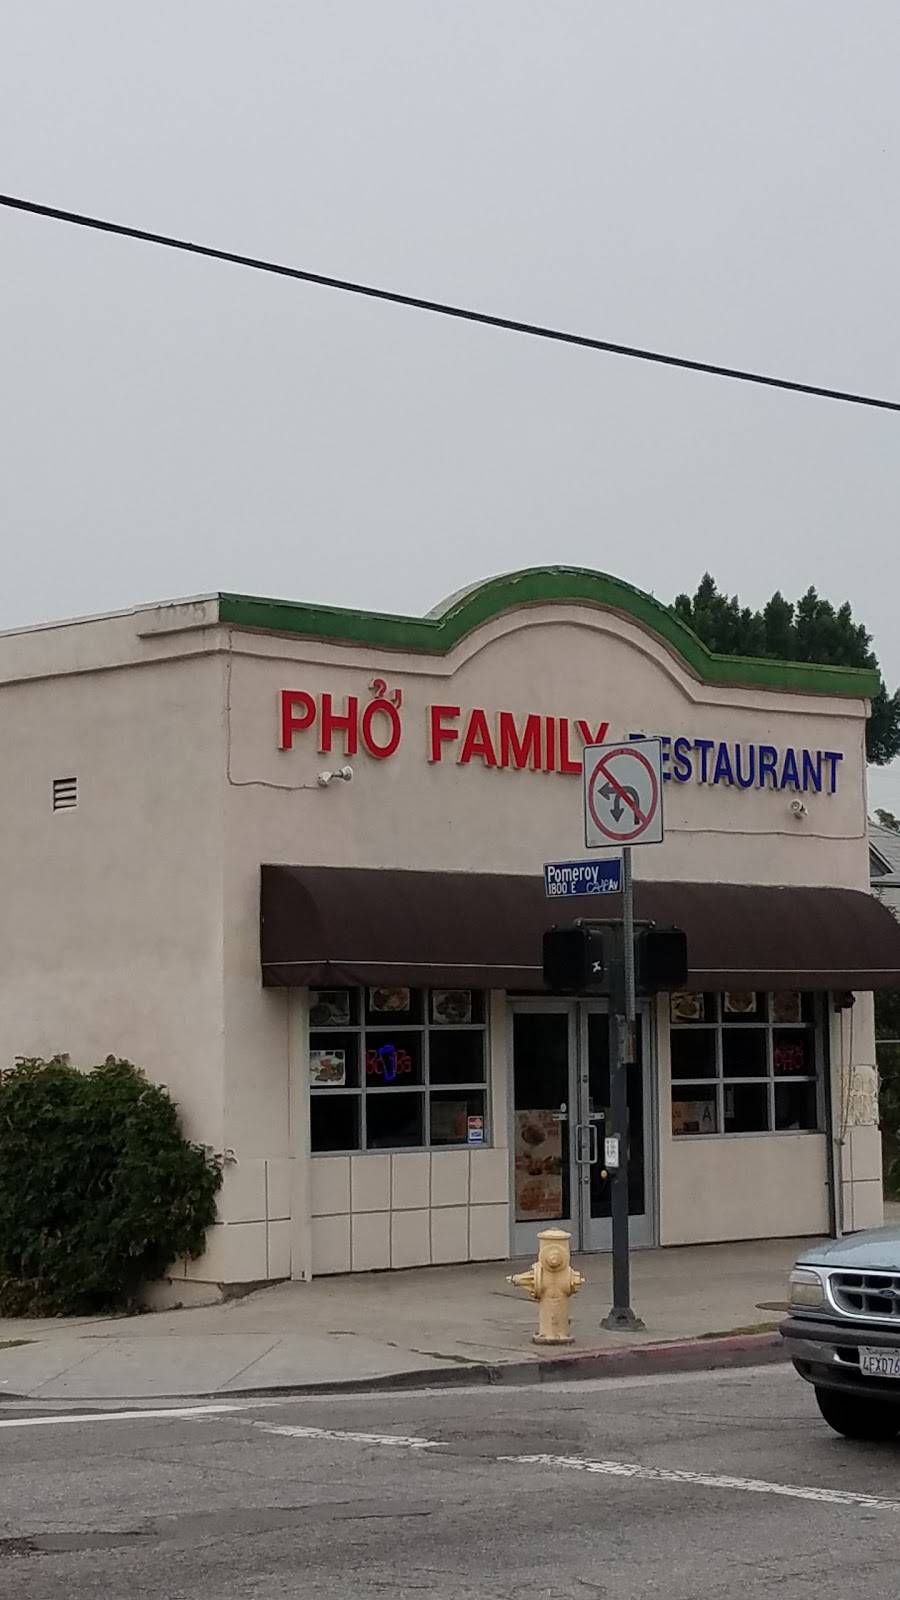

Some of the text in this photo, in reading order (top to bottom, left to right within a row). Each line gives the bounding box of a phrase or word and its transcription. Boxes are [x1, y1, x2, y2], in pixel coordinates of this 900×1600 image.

[629, 733, 843, 794] ESTAURANT
[548, 866, 600, 884] Pomeroy
[549, 882, 568, 895] 1800
[571, 881, 577, 894] E
[608, 878, 619, 891] Av
[703, 1106, 712, 1121] A
